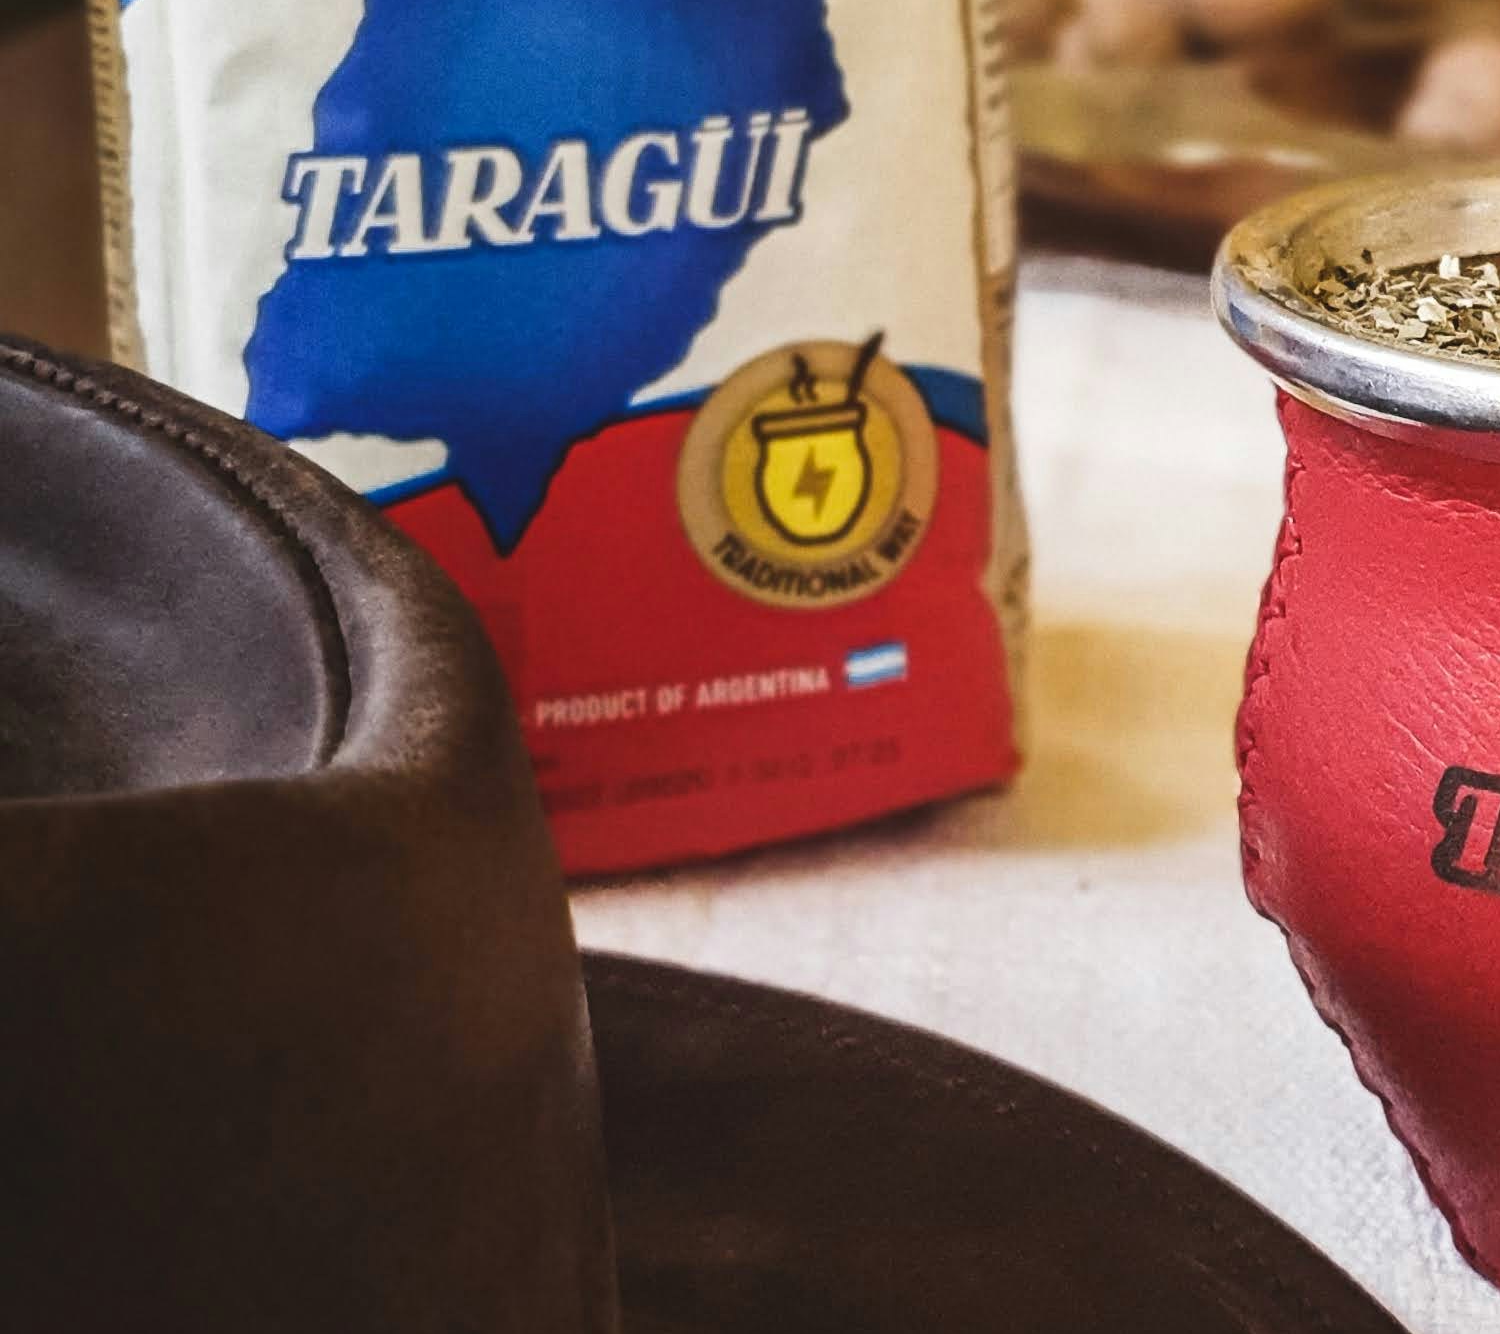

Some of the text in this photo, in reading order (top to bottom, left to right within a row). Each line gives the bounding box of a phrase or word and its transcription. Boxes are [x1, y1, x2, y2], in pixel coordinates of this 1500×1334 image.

[712, 532, 883, 597] TRADITIONAL
[535, 667, 830, 727] PRODUCT OF ARGENTINA
